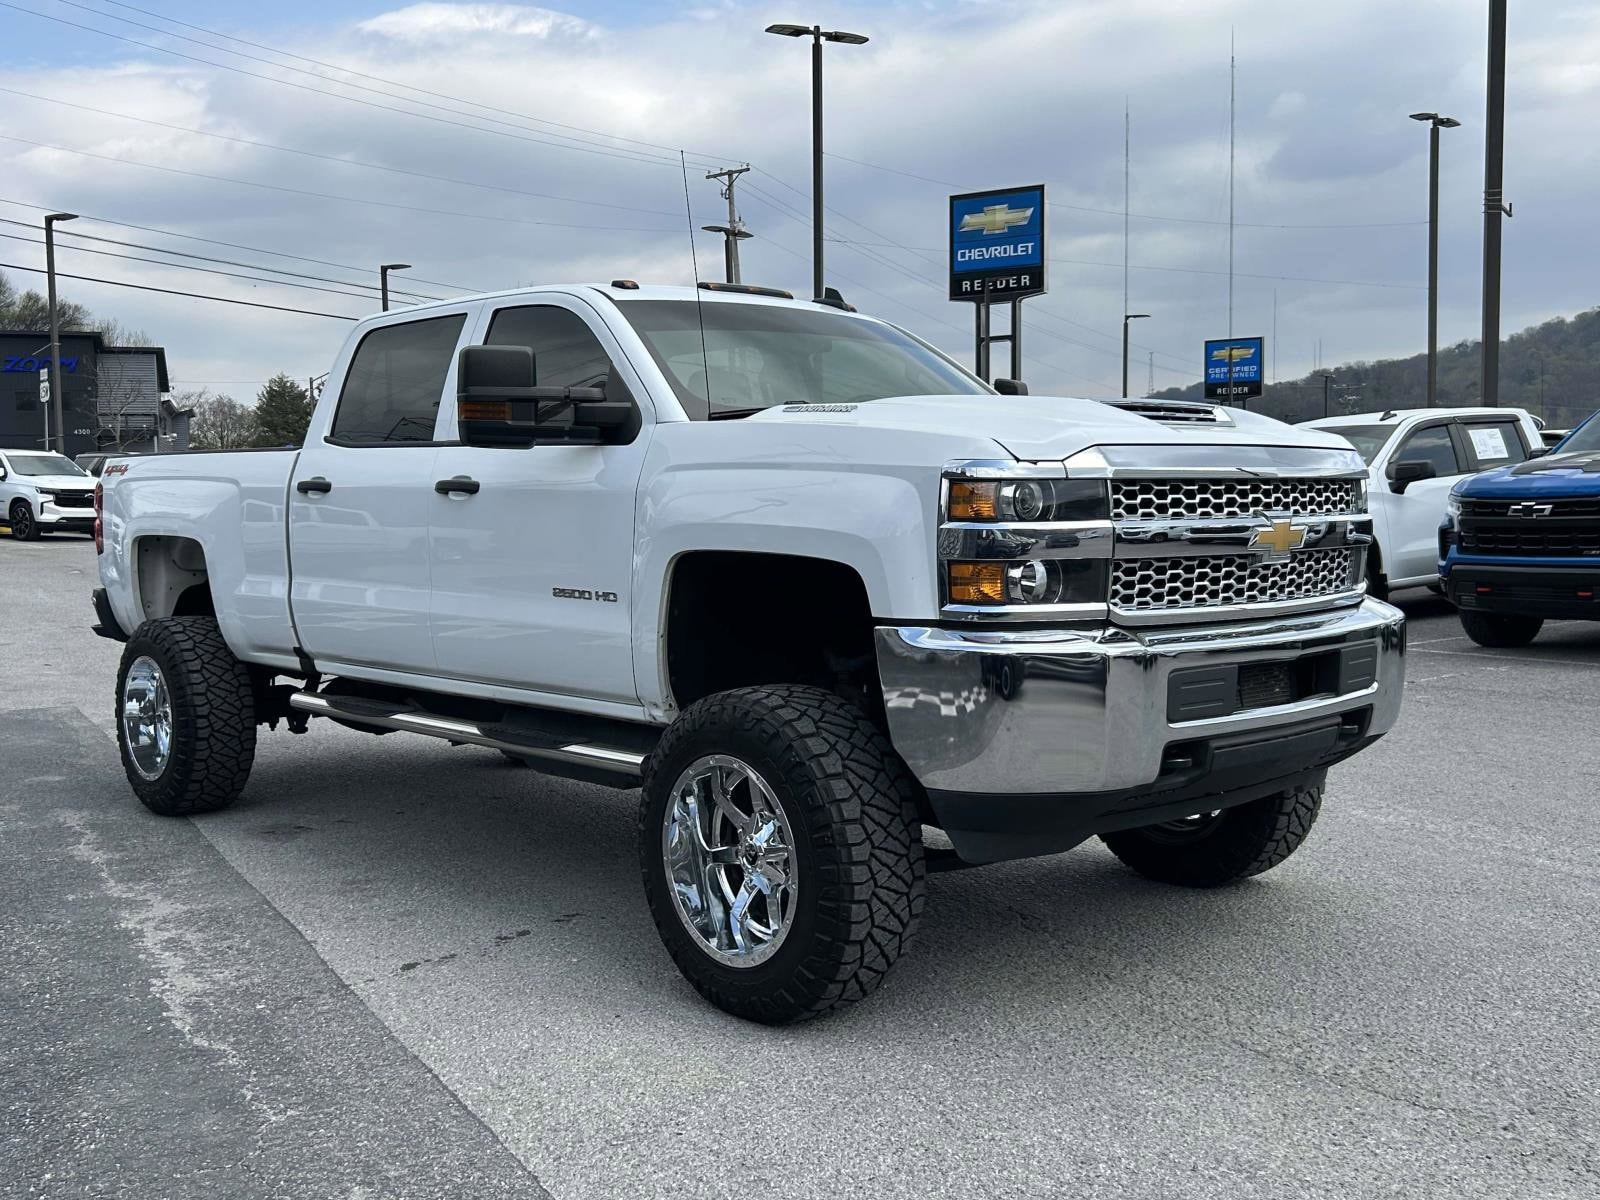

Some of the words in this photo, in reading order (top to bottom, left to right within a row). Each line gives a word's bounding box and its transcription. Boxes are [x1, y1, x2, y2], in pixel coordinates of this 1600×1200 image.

[957, 242, 1035, 261] CHEVROLET
[1208, 365, 1257, 374] CERIFIED
[1210, 371, 1255, 379] PRE-WNED
[552, 587, 593, 601] 2500
[595, 590, 618, 603] HD
